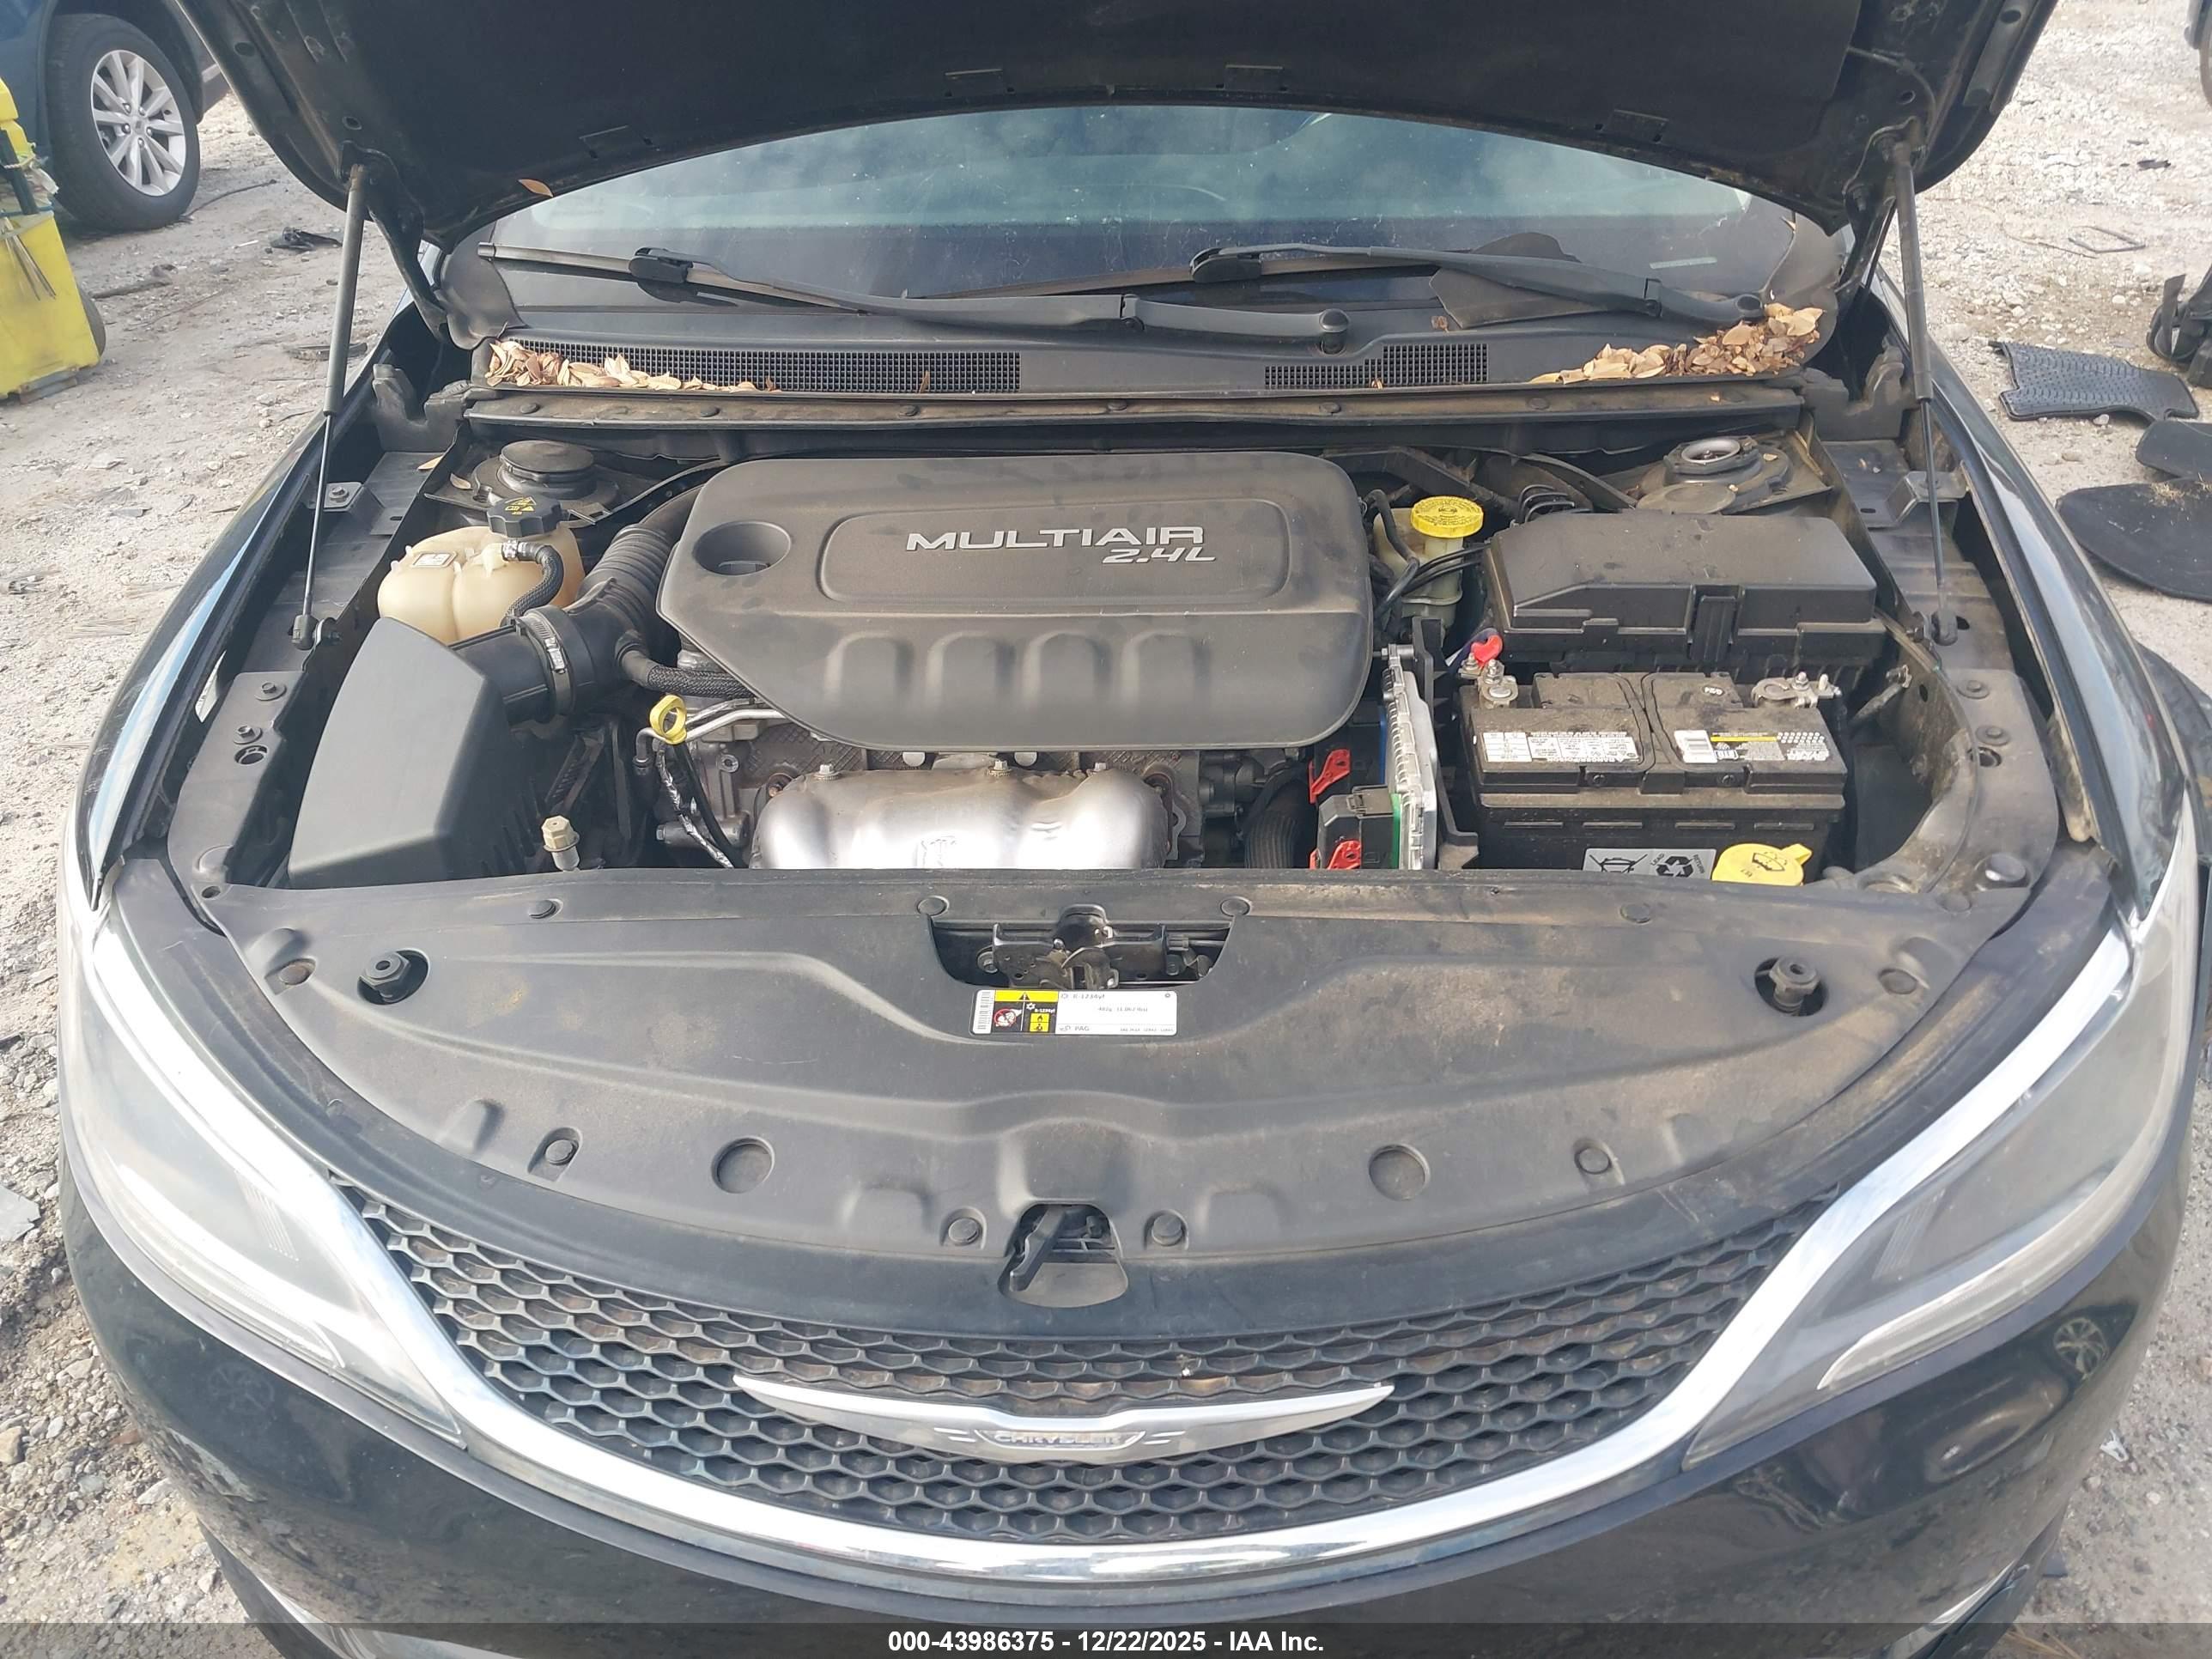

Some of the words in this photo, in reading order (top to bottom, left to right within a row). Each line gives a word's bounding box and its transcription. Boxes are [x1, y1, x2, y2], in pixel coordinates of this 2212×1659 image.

[906, 526, 1205, 551] MULTIAIR
[1102, 546, 1217, 564] 2.4L
[1650, 853, 1666, 866] LEAD
[994, 1431, 1121, 1443] CHRYSLER
